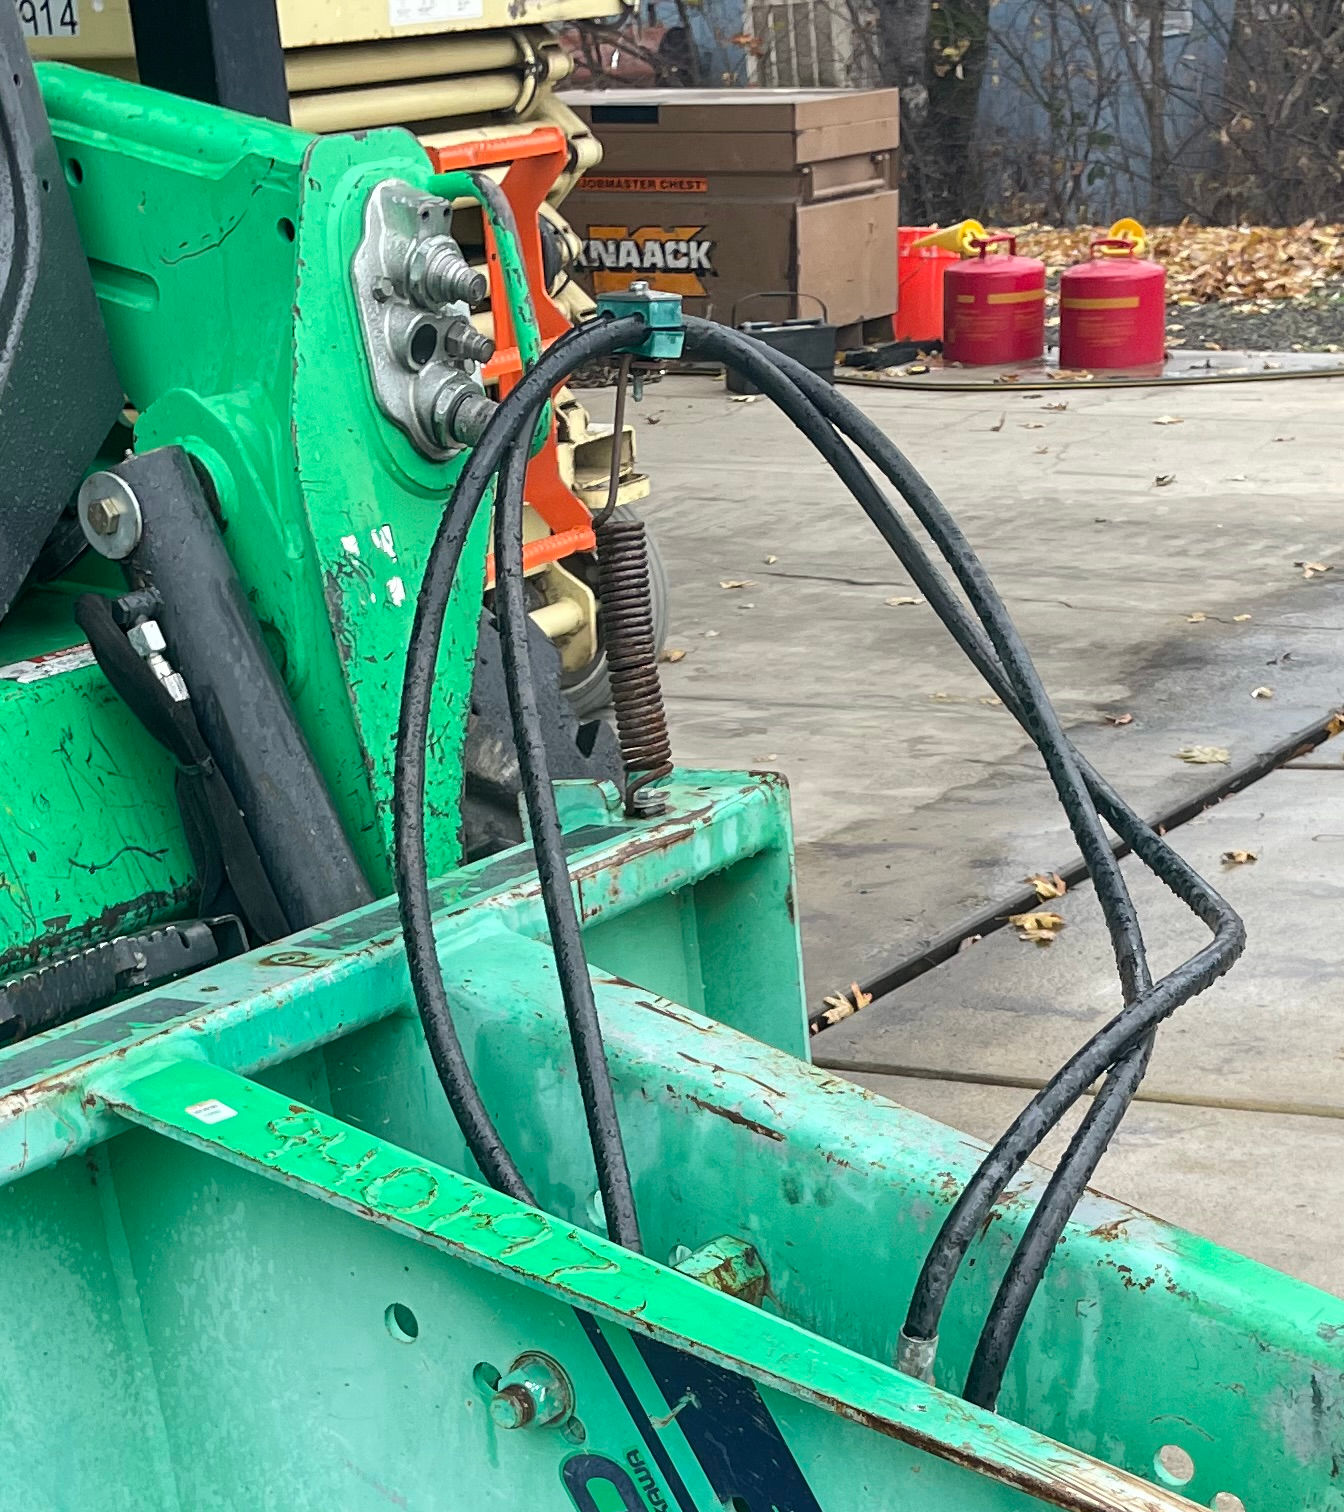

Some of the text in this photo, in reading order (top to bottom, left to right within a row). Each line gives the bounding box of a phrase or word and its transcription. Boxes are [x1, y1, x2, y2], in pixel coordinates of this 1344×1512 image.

[580, 178, 702, 191] JOBMASTER CHEST
[572, 240, 713, 270] KNAACK
